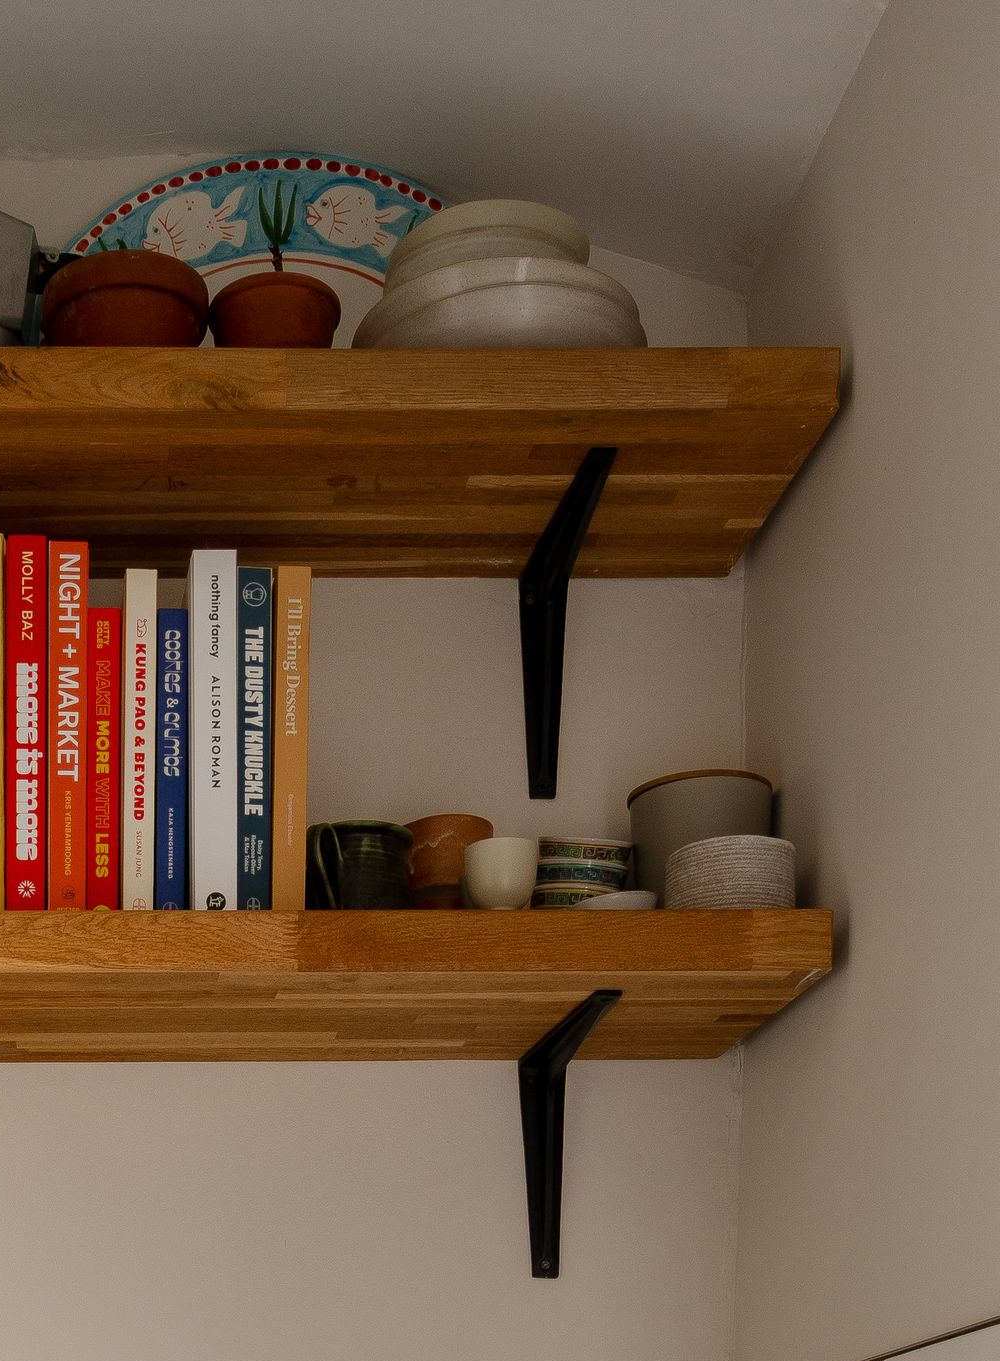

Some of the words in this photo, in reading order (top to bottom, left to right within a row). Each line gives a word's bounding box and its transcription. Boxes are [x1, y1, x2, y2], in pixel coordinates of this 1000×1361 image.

[21, 551, 34, 604] MOLLY
[58, 553, 81, 640] NIGHT
[208, 575, 221, 621] nothing
[21, 609, 34, 641] BAZ
[62, 643, 78, 659] +
[96, 620, 104, 649] COLES
[102, 620, 110, 646] KITTY
[209, 624, 221, 658] fancy
[244, 626, 264, 663] THE
[282, 623, 302, 673] Bring
[135, 643, 147, 692] KUNG
[164, 629, 184, 693] cookies
[15, 662, 39, 745] more
[95, 660, 111, 716] MAKE
[134, 696, 146, 731] PAO
[165, 697, 179, 709] &
[211, 675, 221, 729] ALISON
[244, 665, 264, 728] DUSTY
[285, 673, 301, 737] Dessert
[57, 666, 80, 783] MARKET
[95, 720, 110, 774] MORE
[134, 735, 146, 747] &
[163, 712, 184, 777] crumbs
[15, 748, 44, 776] is
[133, 752, 145, 821] BEYOND
[211, 735, 221, 789] ROMAN
[244, 729, 264, 817] KNUCKLE
[15, 778, 39, 862] more
[64, 790, 72, 810] KRIS
[95, 777, 110, 829] WITH
[64, 811, 72, 876] YENBAMROONG
[95, 833, 110, 878] LESS
